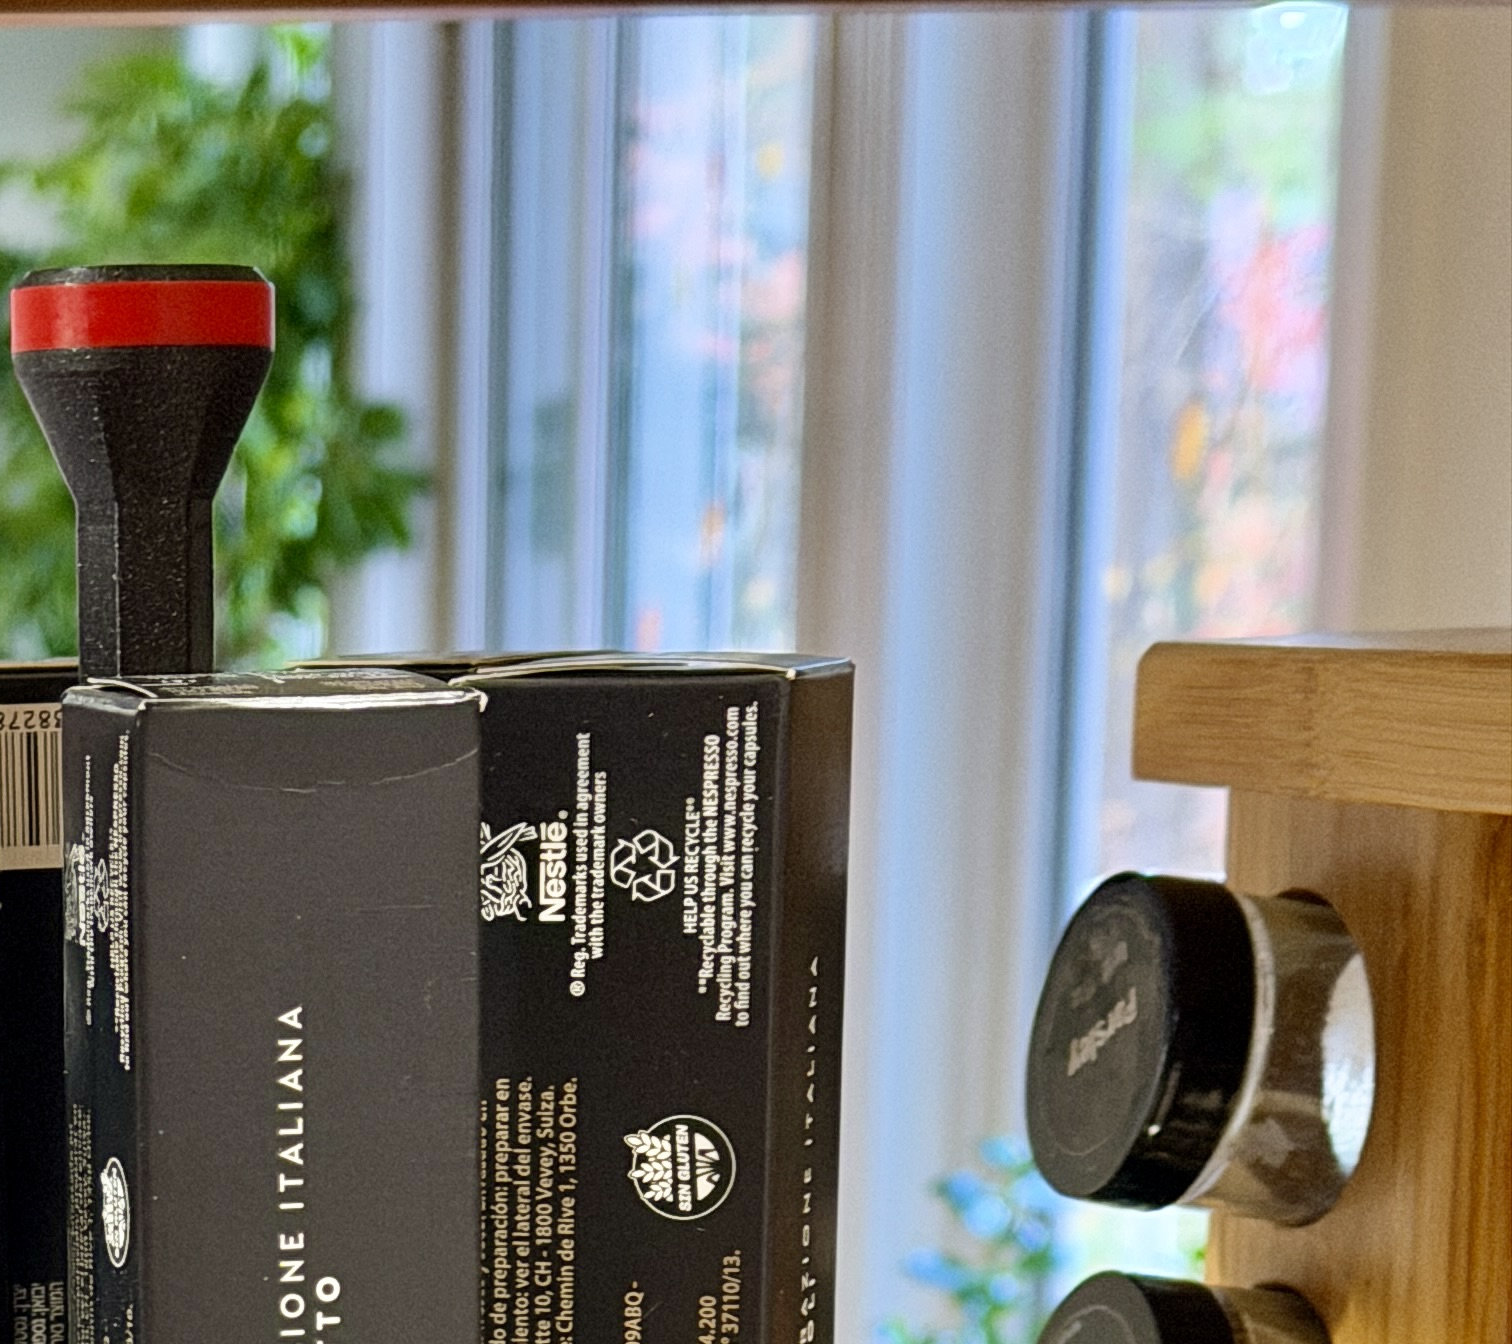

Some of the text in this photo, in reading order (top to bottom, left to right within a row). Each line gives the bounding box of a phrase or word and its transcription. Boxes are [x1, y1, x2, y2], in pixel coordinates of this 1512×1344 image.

[702, 735, 720, 816] NESPRESSO
[570, 733, 593, 977] Reg. Trademarks used in agreement
[588, 772, 606, 959] with the trademark owners
[702, 819, 717, 843] the
[715, 707, 740, 1020] Recycling Program. Visit www.nespresso.com
[734, 701, 760, 1026] to find out where you can recycle your capsules.
[683, 897, 698, 933] HELP
[684, 876, 698, 894] US
[700, 846, 720, 902] through
[277, 1007, 304, 1209] ITALIANA
[676, 1125, 691, 1211] SIN GLUTEN
[721, 1250, 741, 1333] 37110/13.
